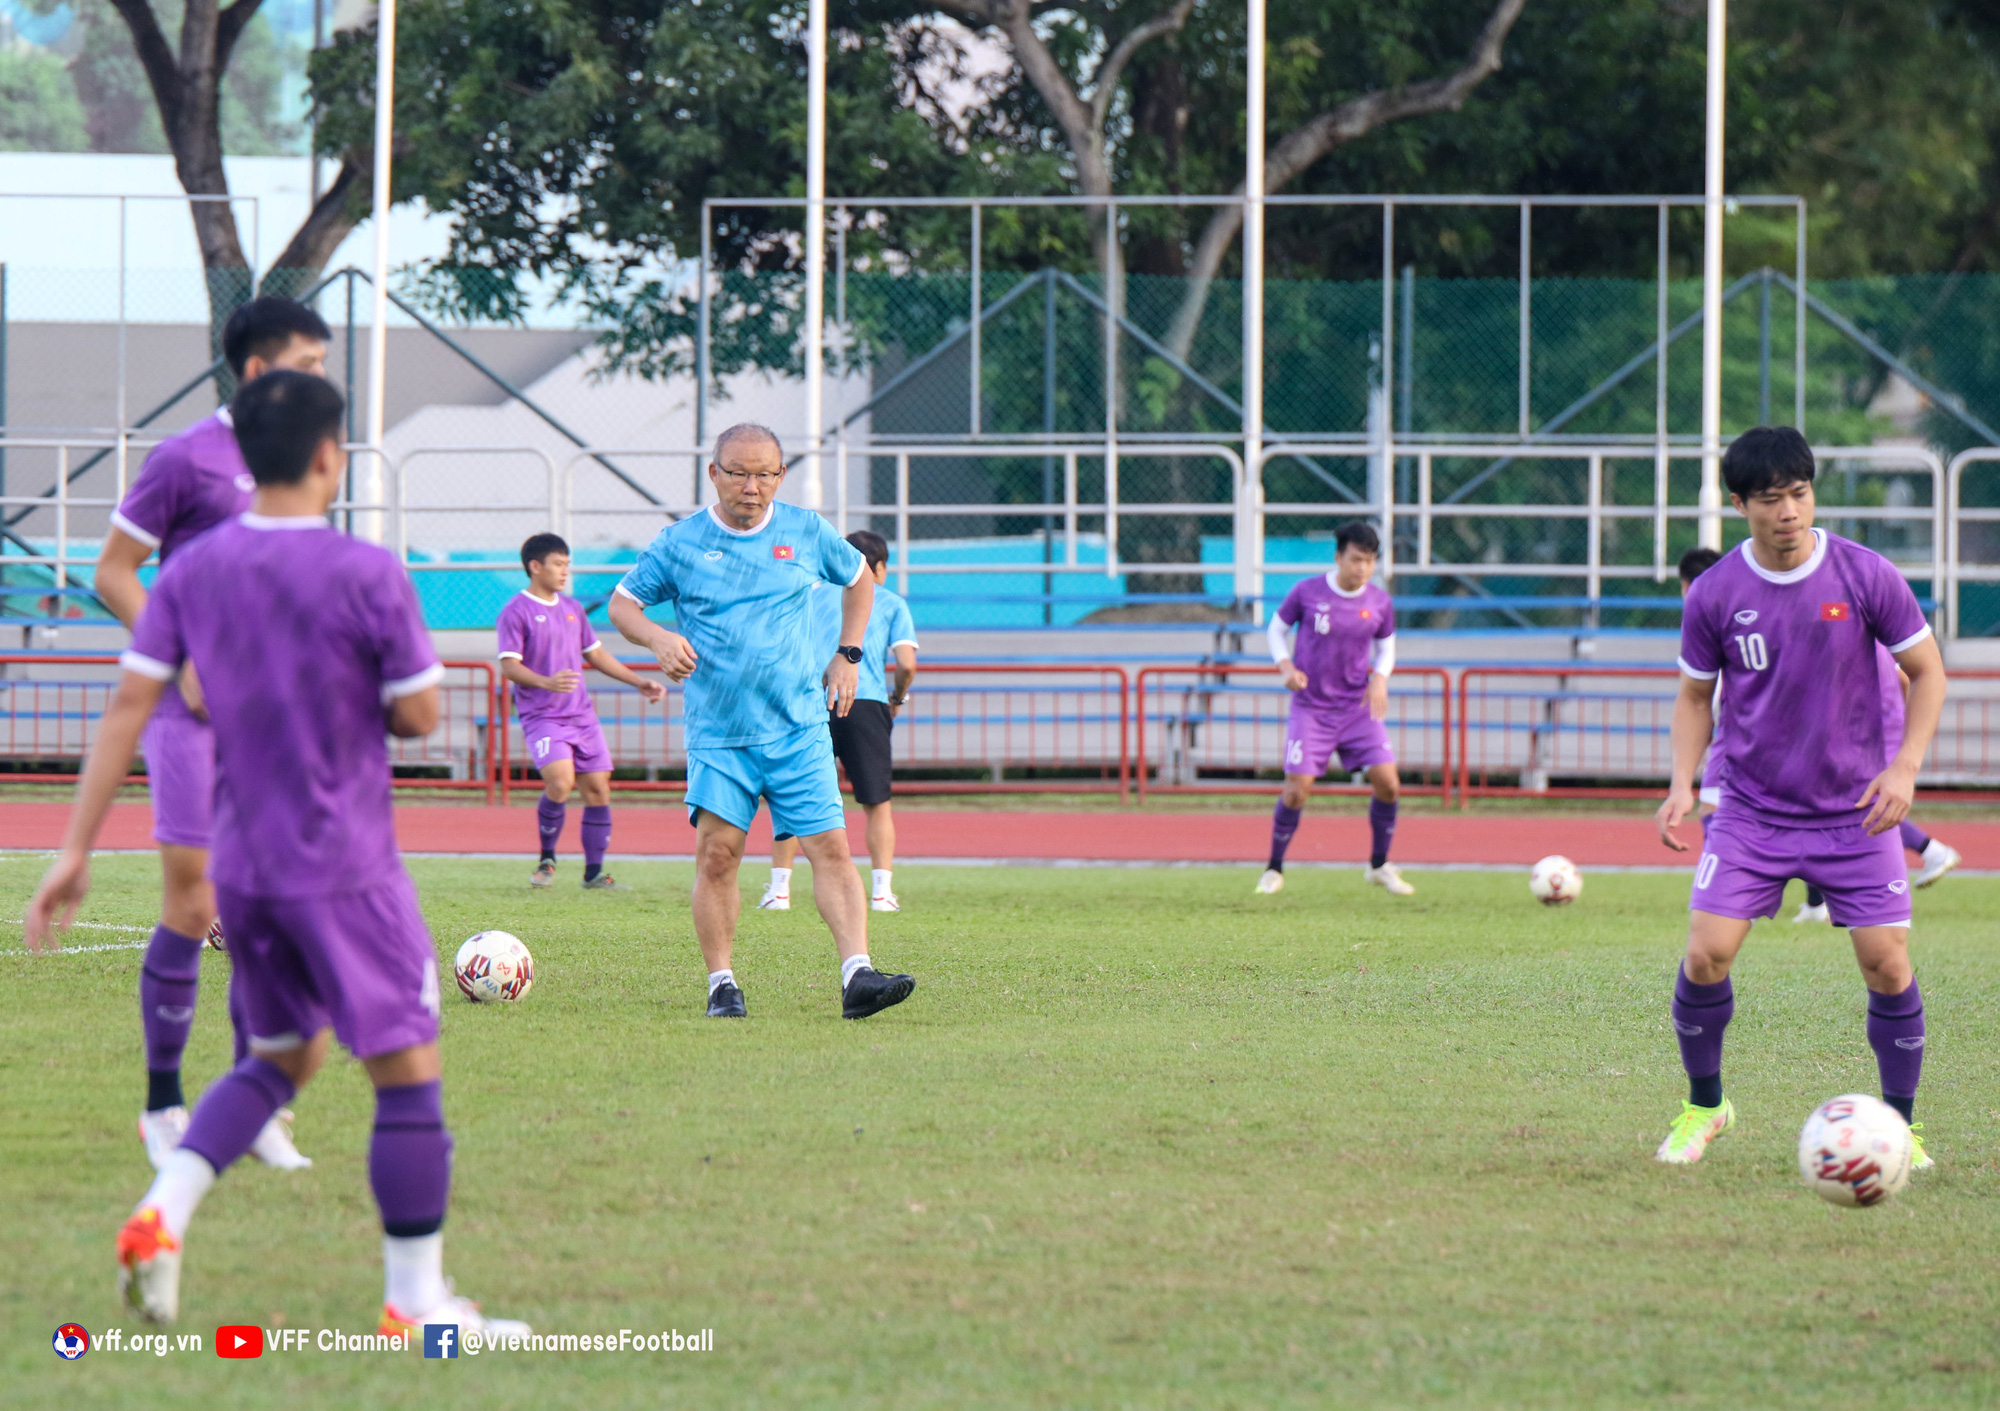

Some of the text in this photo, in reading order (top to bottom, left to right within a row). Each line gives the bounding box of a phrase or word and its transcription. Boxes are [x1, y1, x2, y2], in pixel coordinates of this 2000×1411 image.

[1314, 612, 1330, 635] 16
[1734, 633, 1768, 670] 10
[535, 736, 551, 758] 27
[1287, 739, 1303, 765] 16
